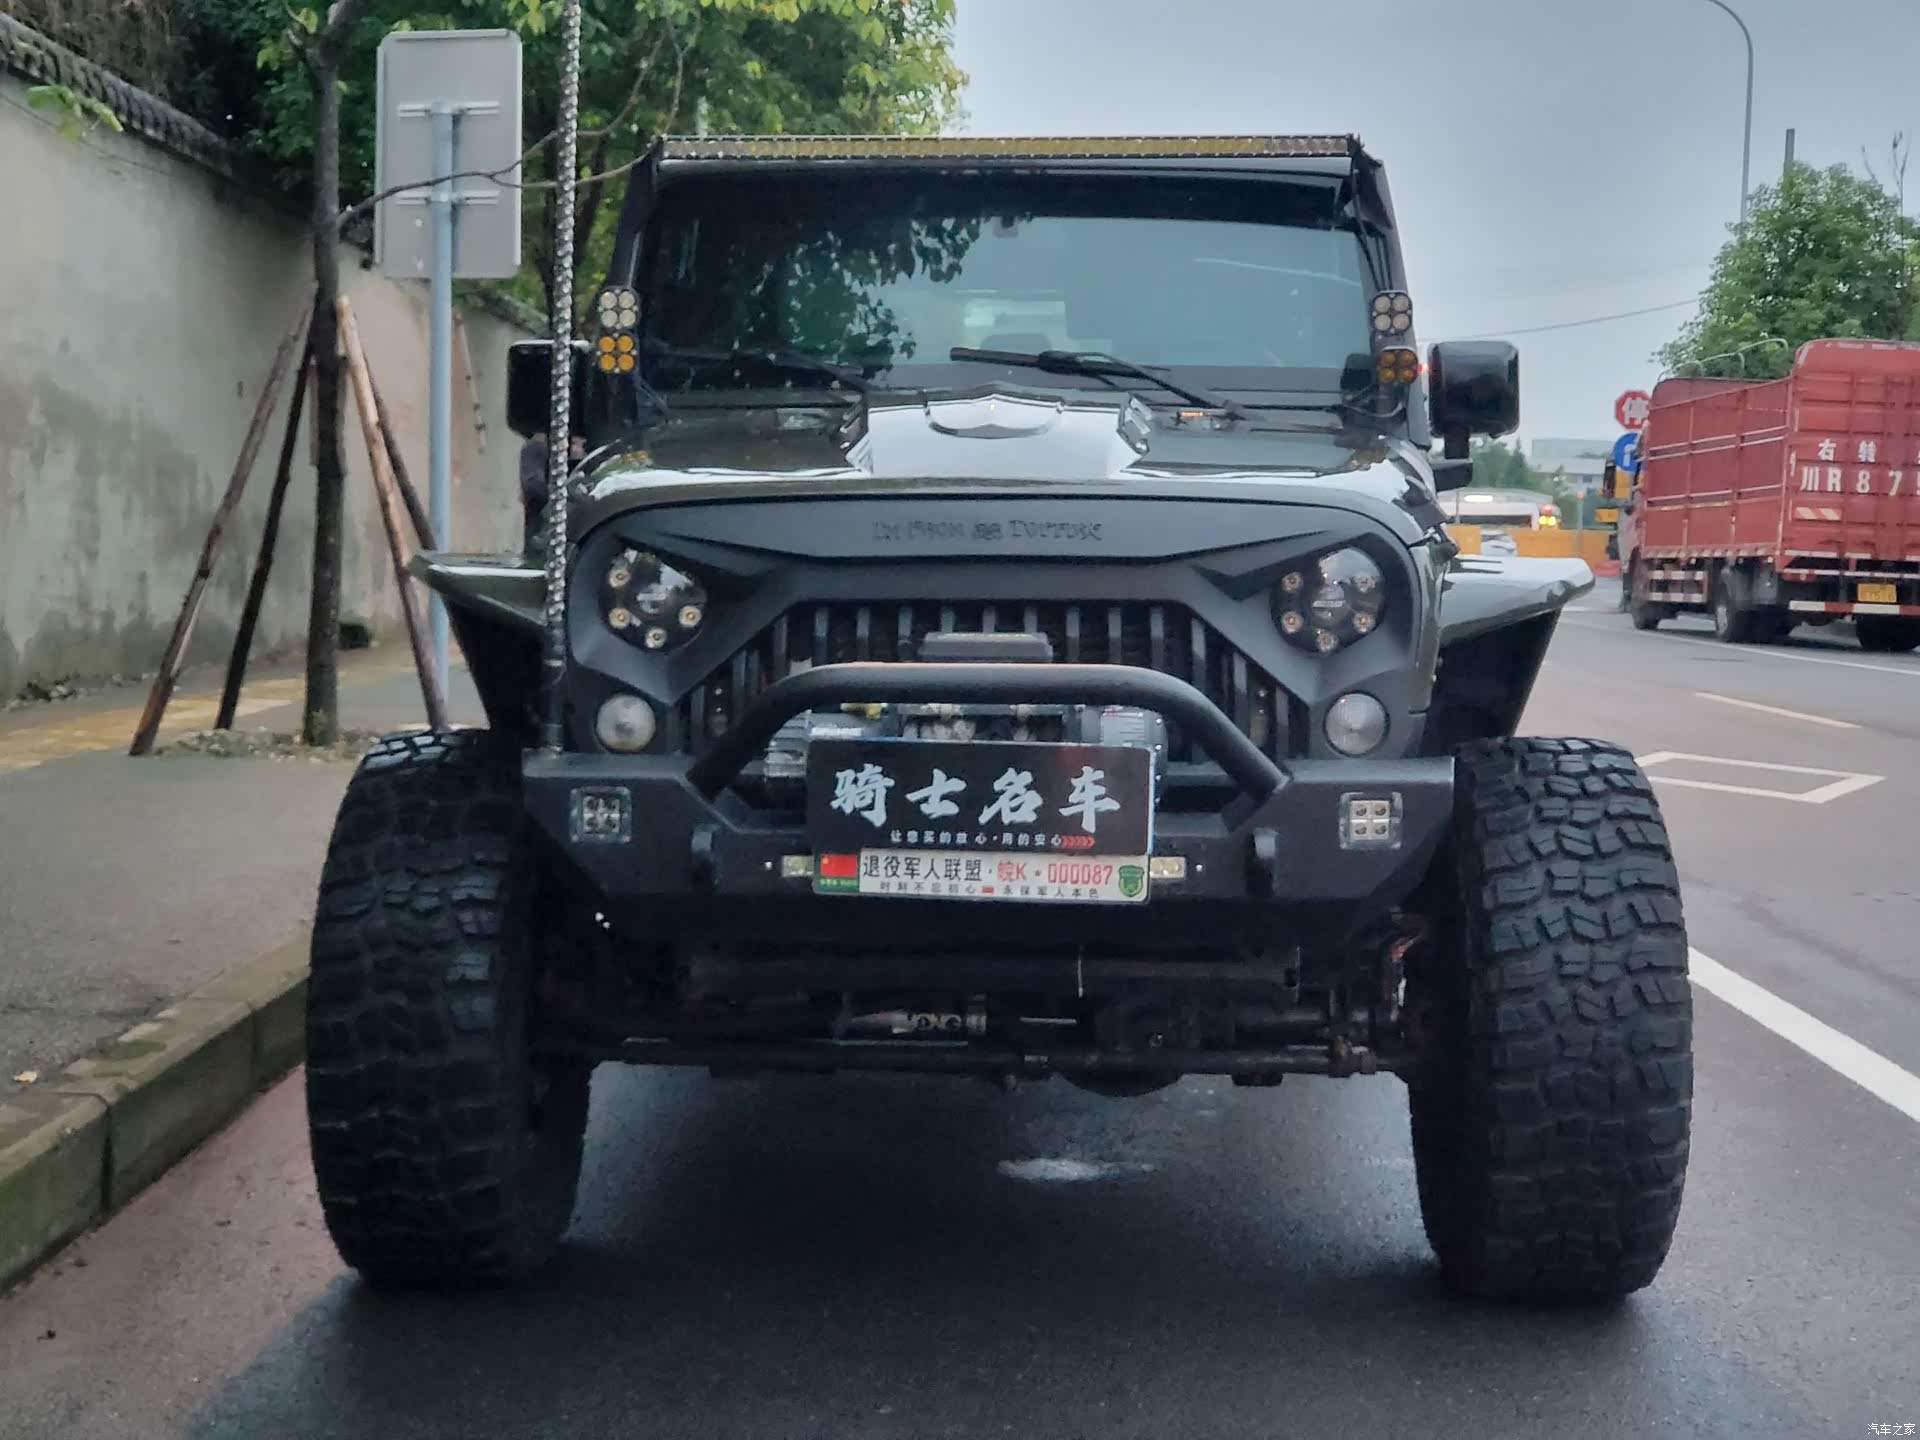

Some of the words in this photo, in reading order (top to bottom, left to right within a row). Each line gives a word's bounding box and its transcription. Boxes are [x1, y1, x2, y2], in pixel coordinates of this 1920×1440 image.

[1801, 466, 1920, 496] 川R87
[829, 763, 1121, 833] 骑士名车
